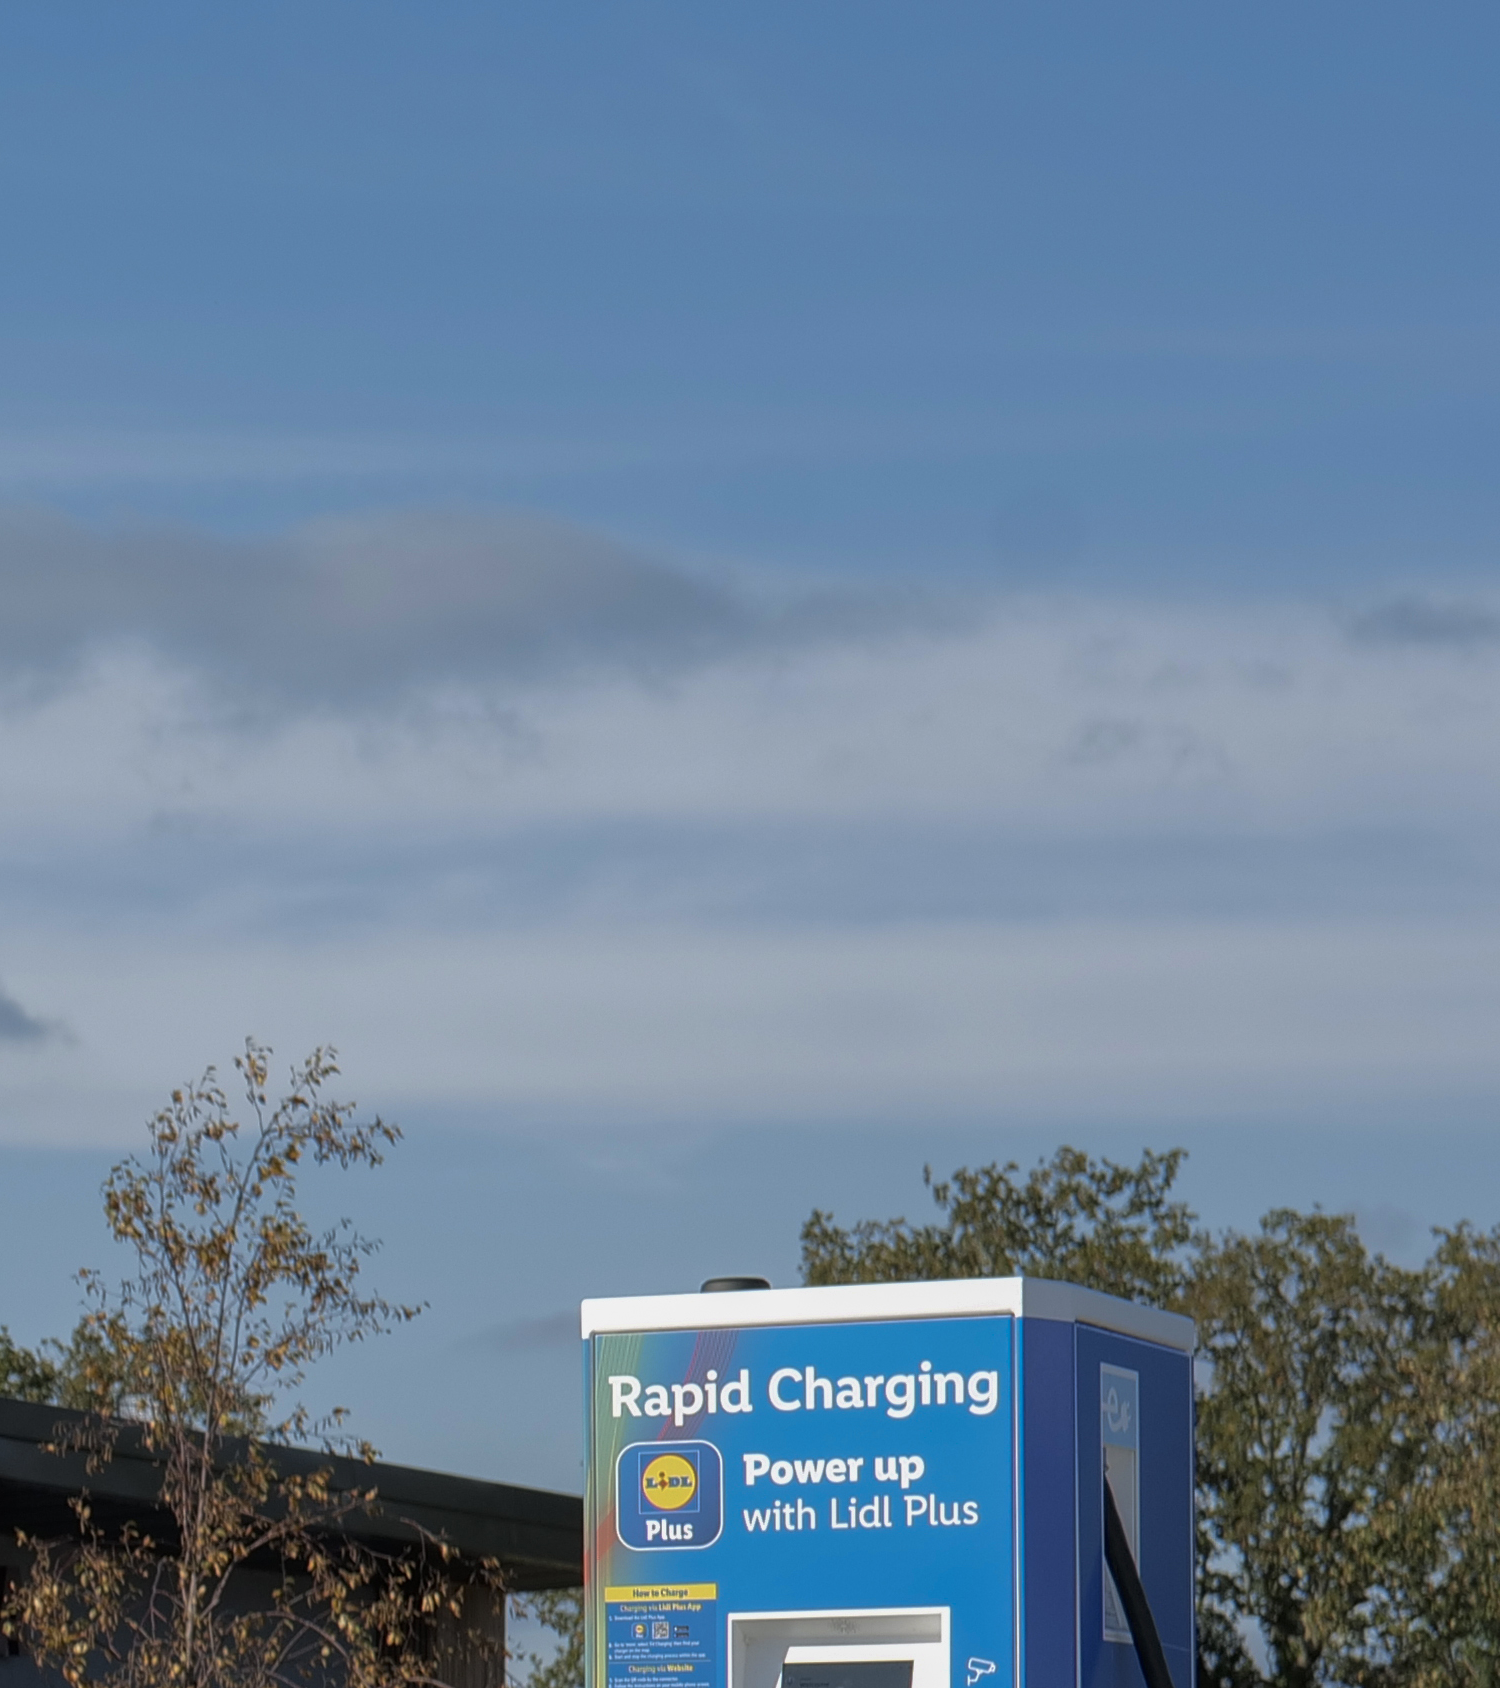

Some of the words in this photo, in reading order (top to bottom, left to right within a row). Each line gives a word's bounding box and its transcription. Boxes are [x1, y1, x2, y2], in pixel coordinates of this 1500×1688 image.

[609, 1371, 752, 1426] Rapid
[768, 1361, 999, 1420] Charging
[743, 1453, 863, 1486] Power
[874, 1457, 925, 1487] up
[742, 1498, 816, 1531] with
[830, 1496, 893, 1529] Lidl
[905, 1494, 979, 1527] Plus
[646, 1518, 693, 1541] Plus
[633, 1589, 651, 1598] How
[651, 1589, 660, 1597] to
[661, 1588, 689, 1599] Charge
[620, 1605, 648, 1613] Charging
[629, 1664, 656, 1673] Charging
[667, 1663, 693, 1672] Website
